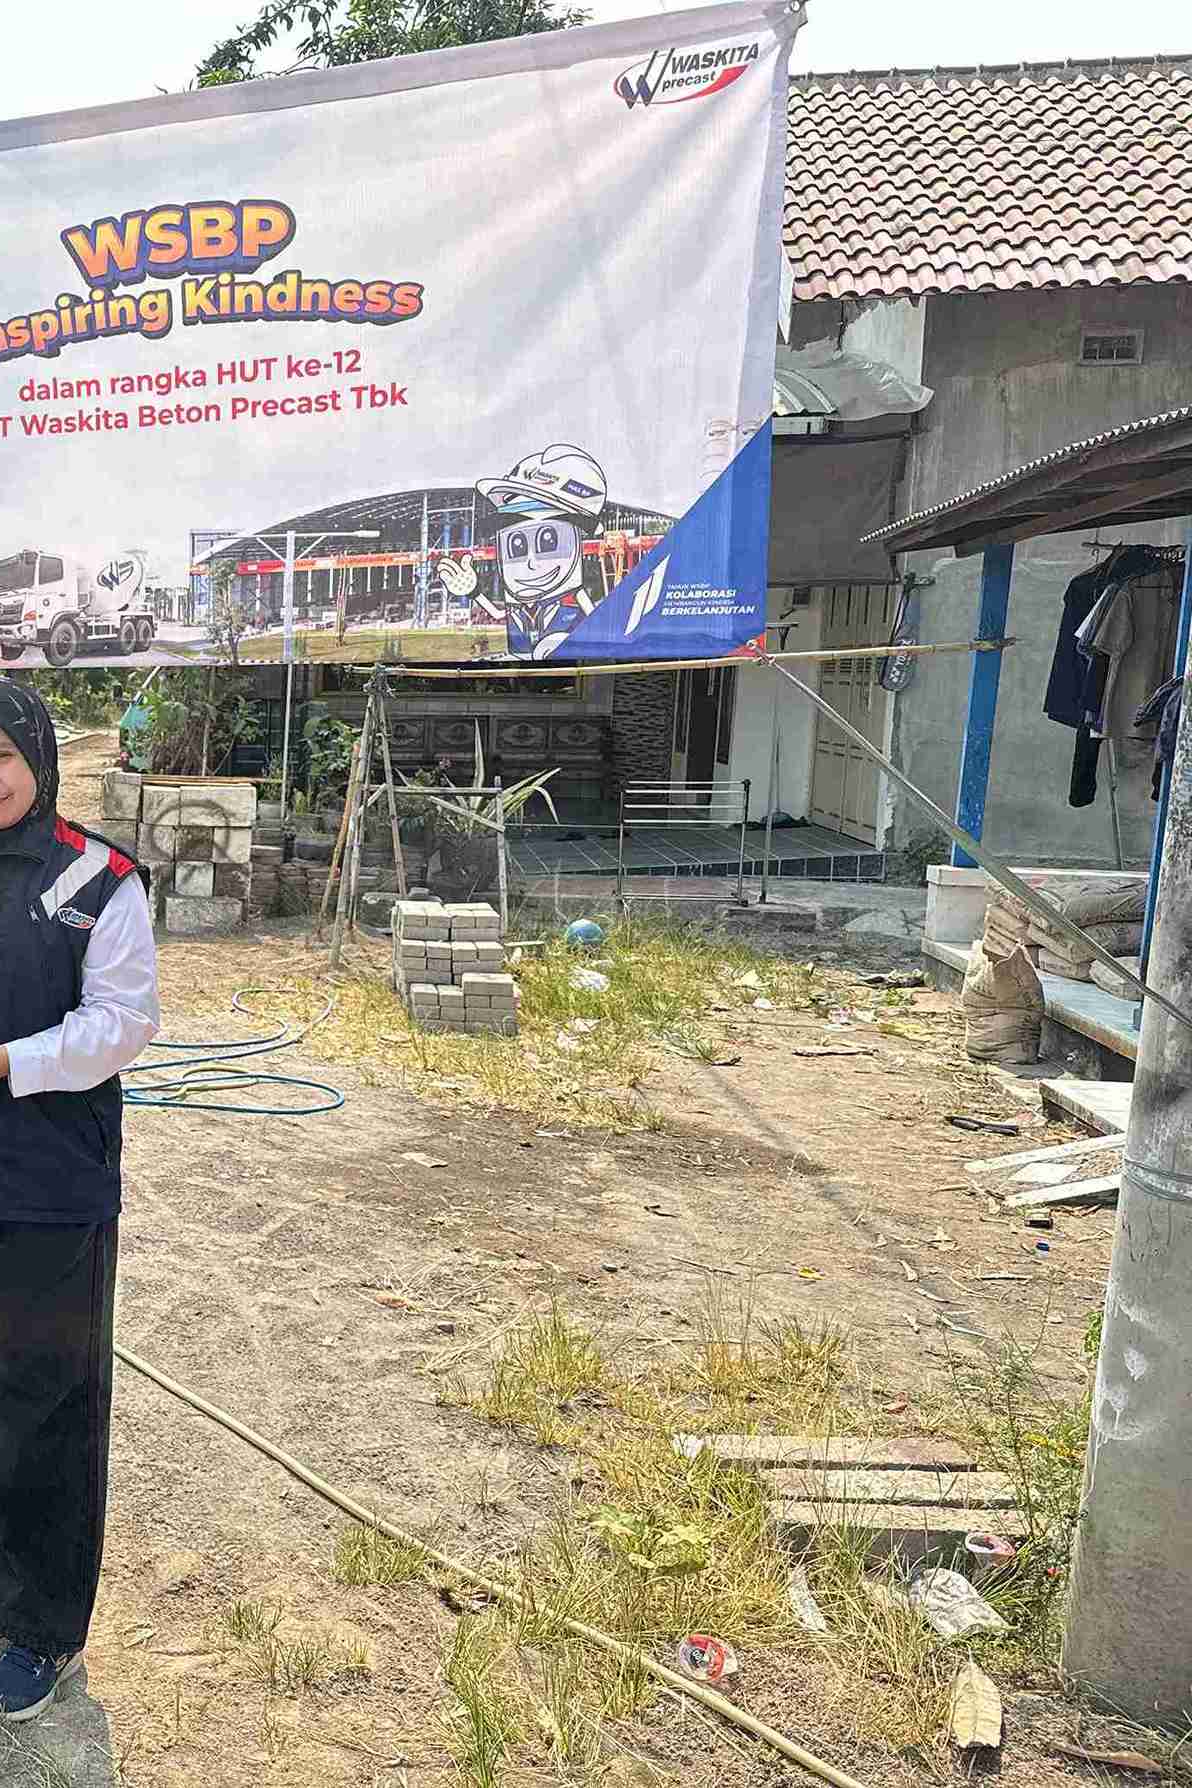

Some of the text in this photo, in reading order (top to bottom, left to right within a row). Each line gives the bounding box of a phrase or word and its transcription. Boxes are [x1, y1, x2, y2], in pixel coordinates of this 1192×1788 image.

[672, 43, 758, 74] WASKITA
[662, 71, 716, 92] precast
[63, 201, 295, 288] WSBP
[182, 270, 423, 324] Kindness
[18, 350, 362, 403] dalam rangka HUT ke-12
[22, 407, 129, 437] Waskita
[139, 404, 221, 428] Beton
[231, 390, 342, 420] Precast
[351, 383, 409, 408] Tbk
[661, 605, 756, 616] BERKELANJUTAN
[665, 588, 737, 600] KOLABORASI
